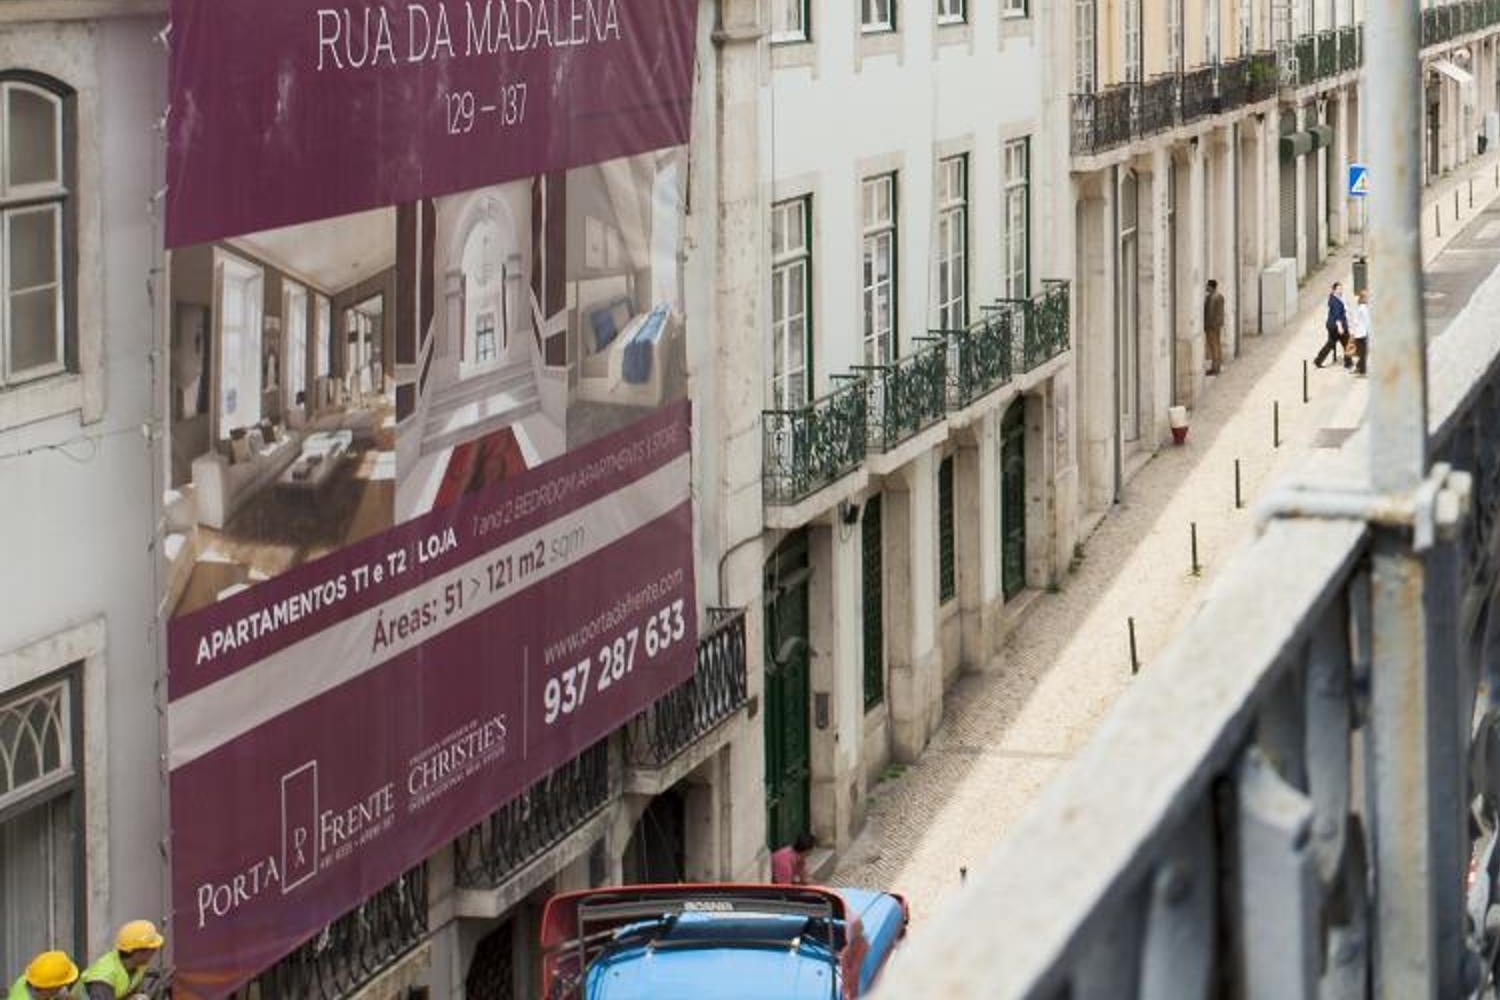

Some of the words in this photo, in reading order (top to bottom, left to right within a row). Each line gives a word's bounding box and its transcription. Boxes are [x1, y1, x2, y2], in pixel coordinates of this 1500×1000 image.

[317, 6, 396, 71] RUA
[408, 3, 456, 62] DA
[446, 91, 475, 135] 129
[500, 83, 527, 126] 137
[196, 576, 347, 665] APARTAMENTOS
[352, 565, 369, 593] T1
[372, 565, 383, 583] e
[387, 549, 406, 577] T2
[418, 527, 458, 563] LOJA
[371, 600, 438, 653] Áreas:
[444, 578, 463, 616] 51
[486, 555, 513, 593] 121
[518, 540, 546, 578] m2
[549, 526, 585, 562] sqm
[544, 657, 591, 724] 937
[598, 626, 640, 691] 287
[645, 599, 685, 658] 633
[197, 856, 279, 928] PORTA
[319, 781, 395, 852] FRENTE
